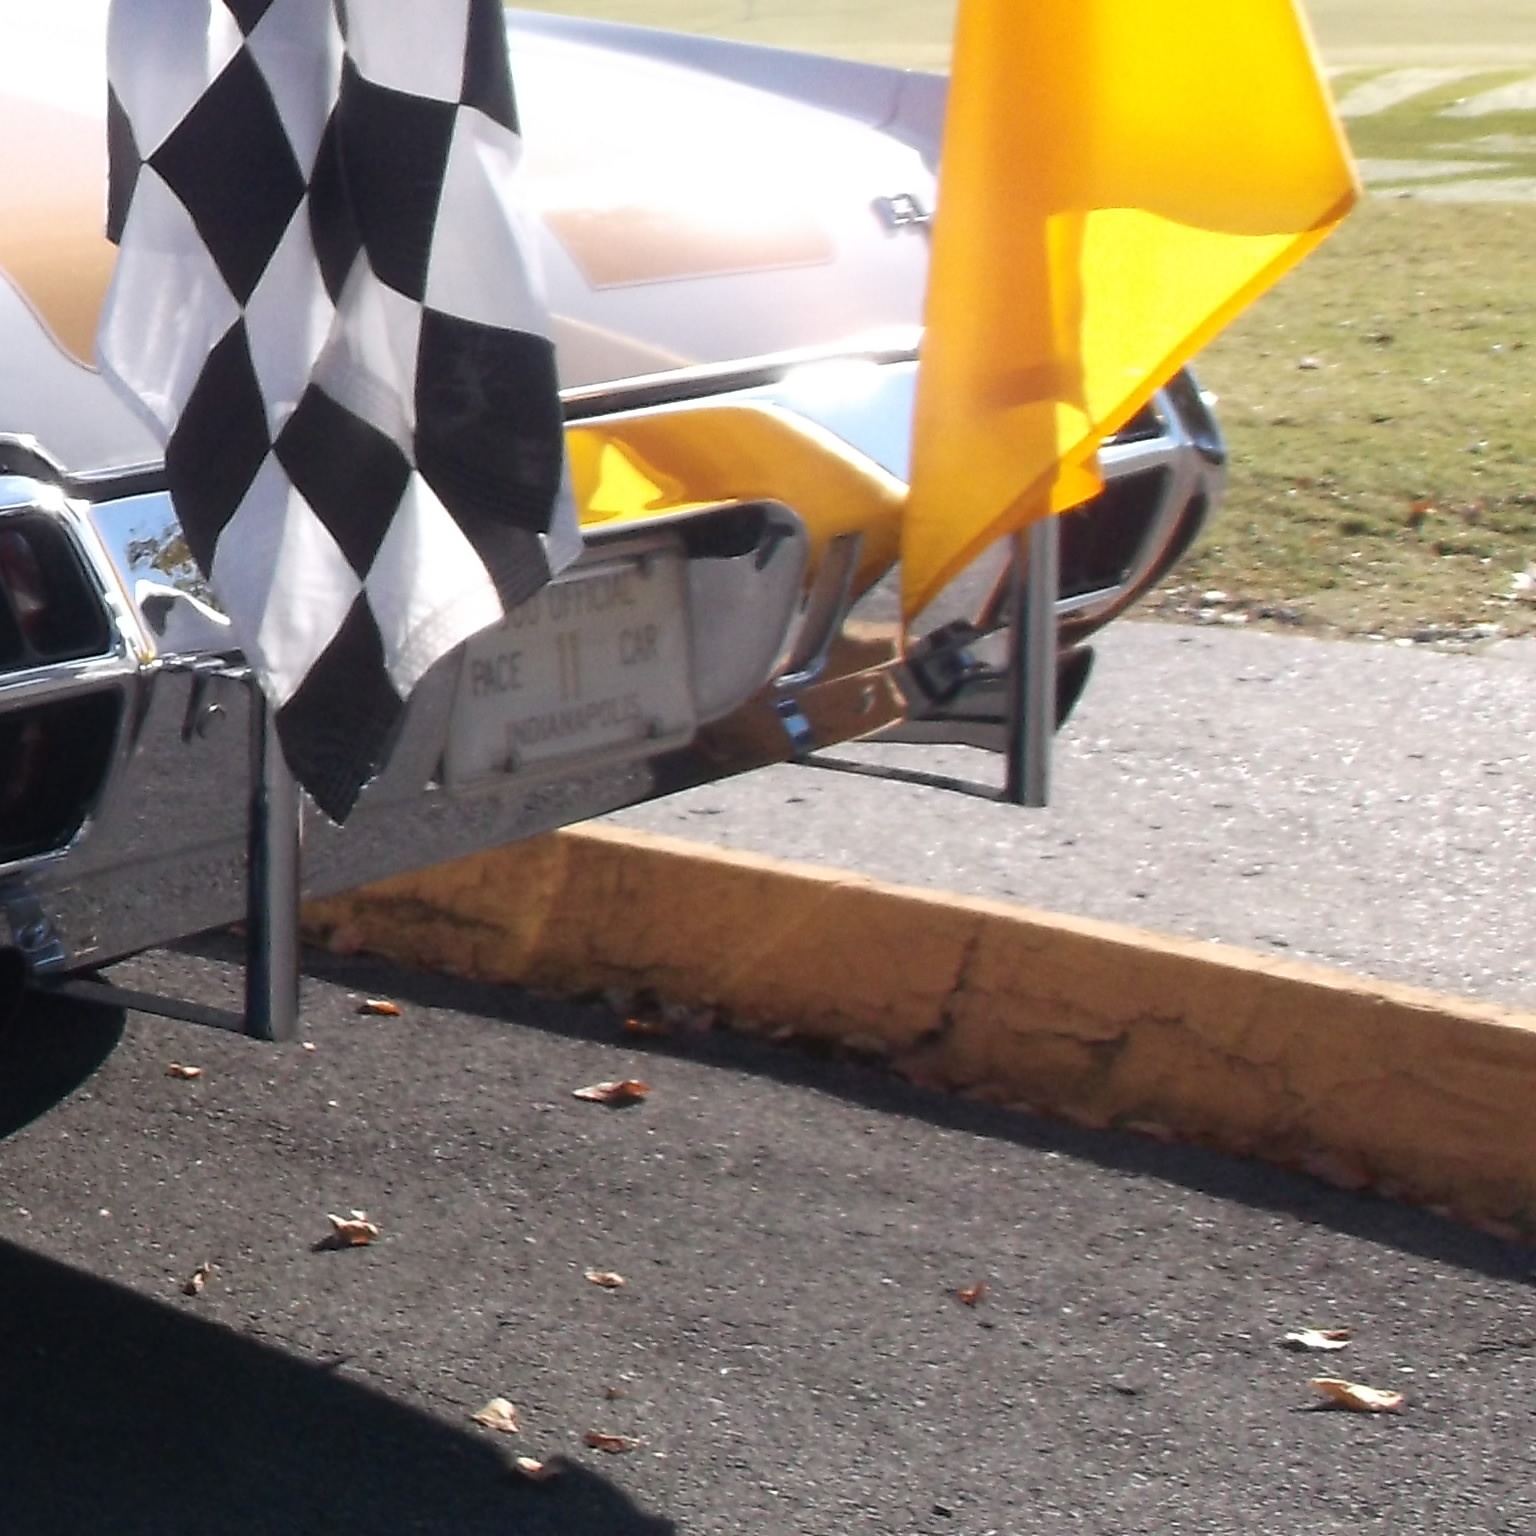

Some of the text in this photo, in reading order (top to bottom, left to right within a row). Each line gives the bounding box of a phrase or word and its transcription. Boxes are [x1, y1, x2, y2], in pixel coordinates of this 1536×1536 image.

[471, 651, 524, 697] PACE
[618, 624, 659, 666] CAR
[504, 692, 642, 749] INDIANAPOLIS
